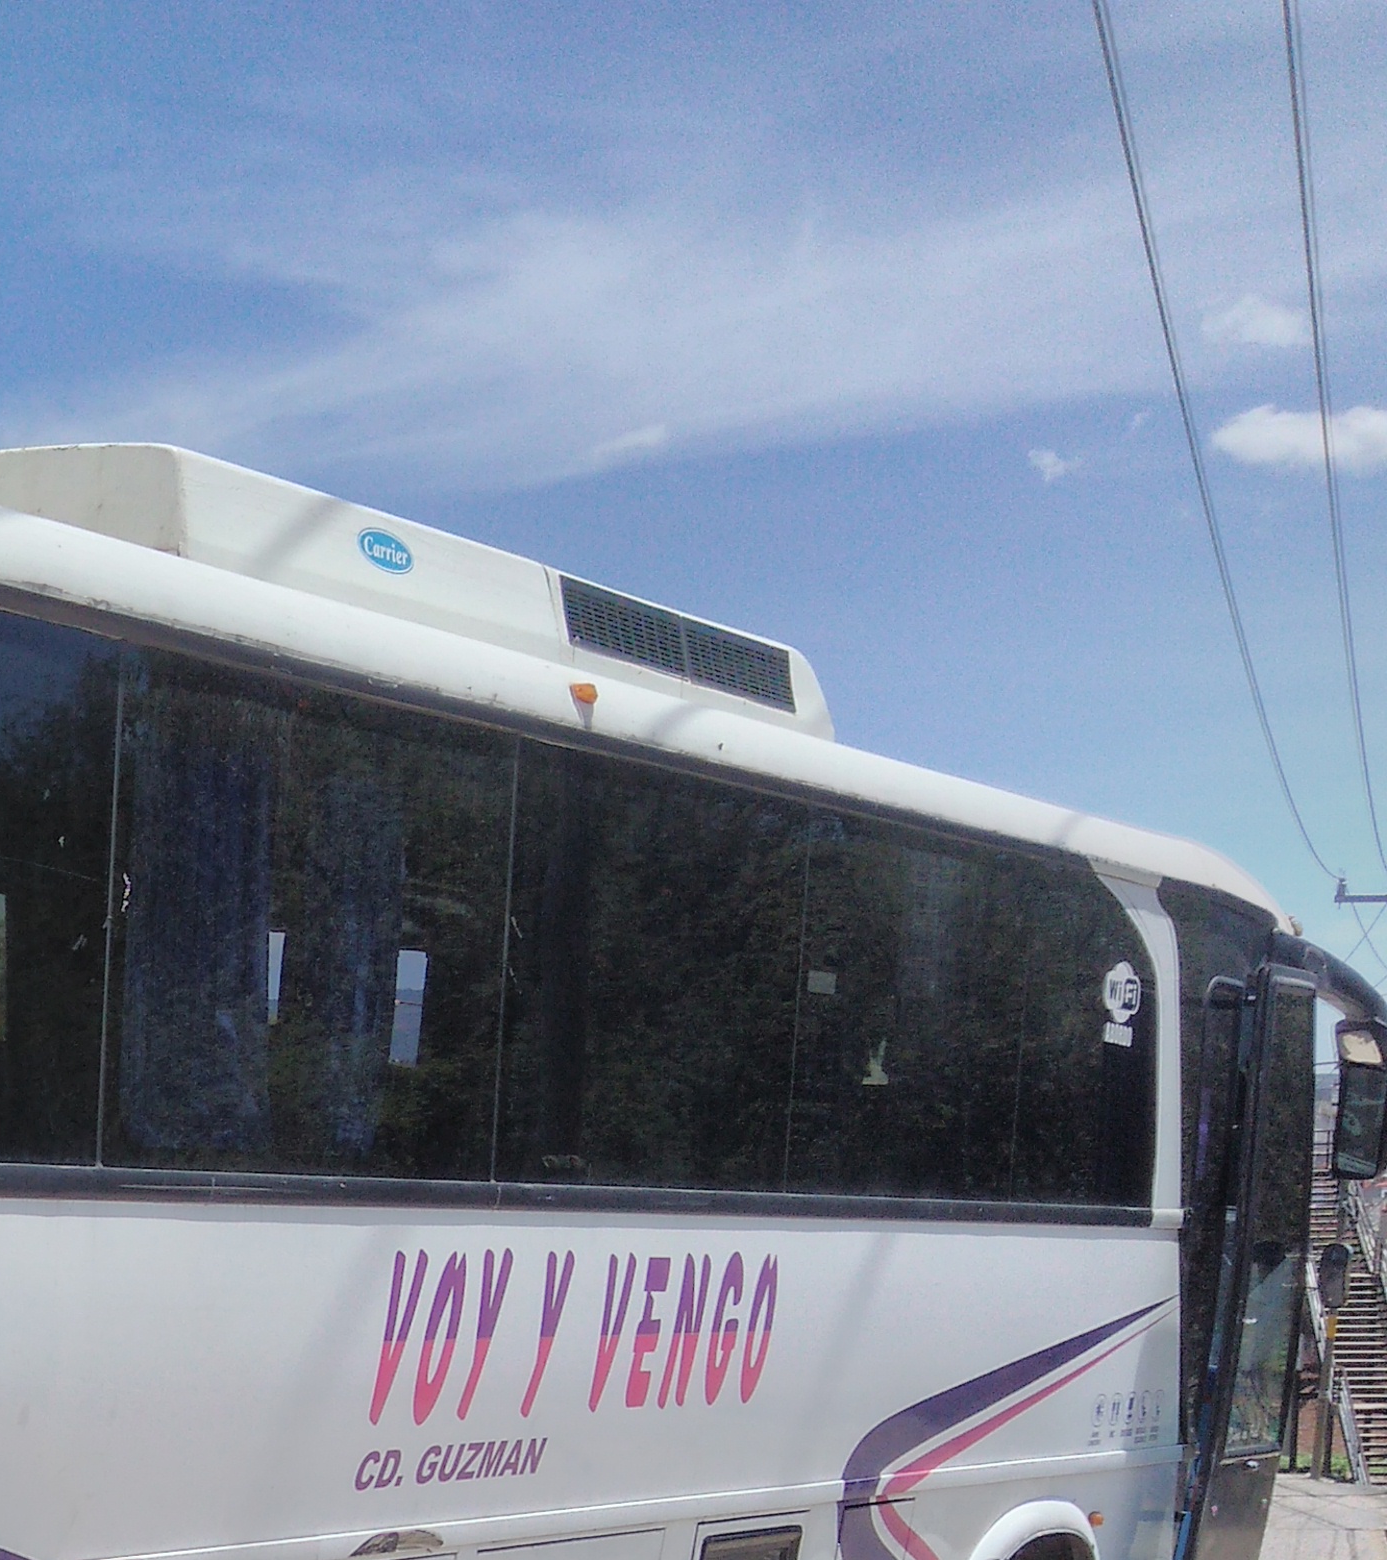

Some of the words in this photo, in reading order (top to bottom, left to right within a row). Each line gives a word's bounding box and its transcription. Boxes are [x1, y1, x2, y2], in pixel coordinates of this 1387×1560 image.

[363, 535, 409, 566] Carrier
[368, 1247, 513, 1426] VOY
[519, 1249, 576, 1419] Y
[588, 1250, 779, 1413] VENGO
[353, 1447, 403, 1491] CD.
[415, 1437, 548, 1485] GUZMAN
